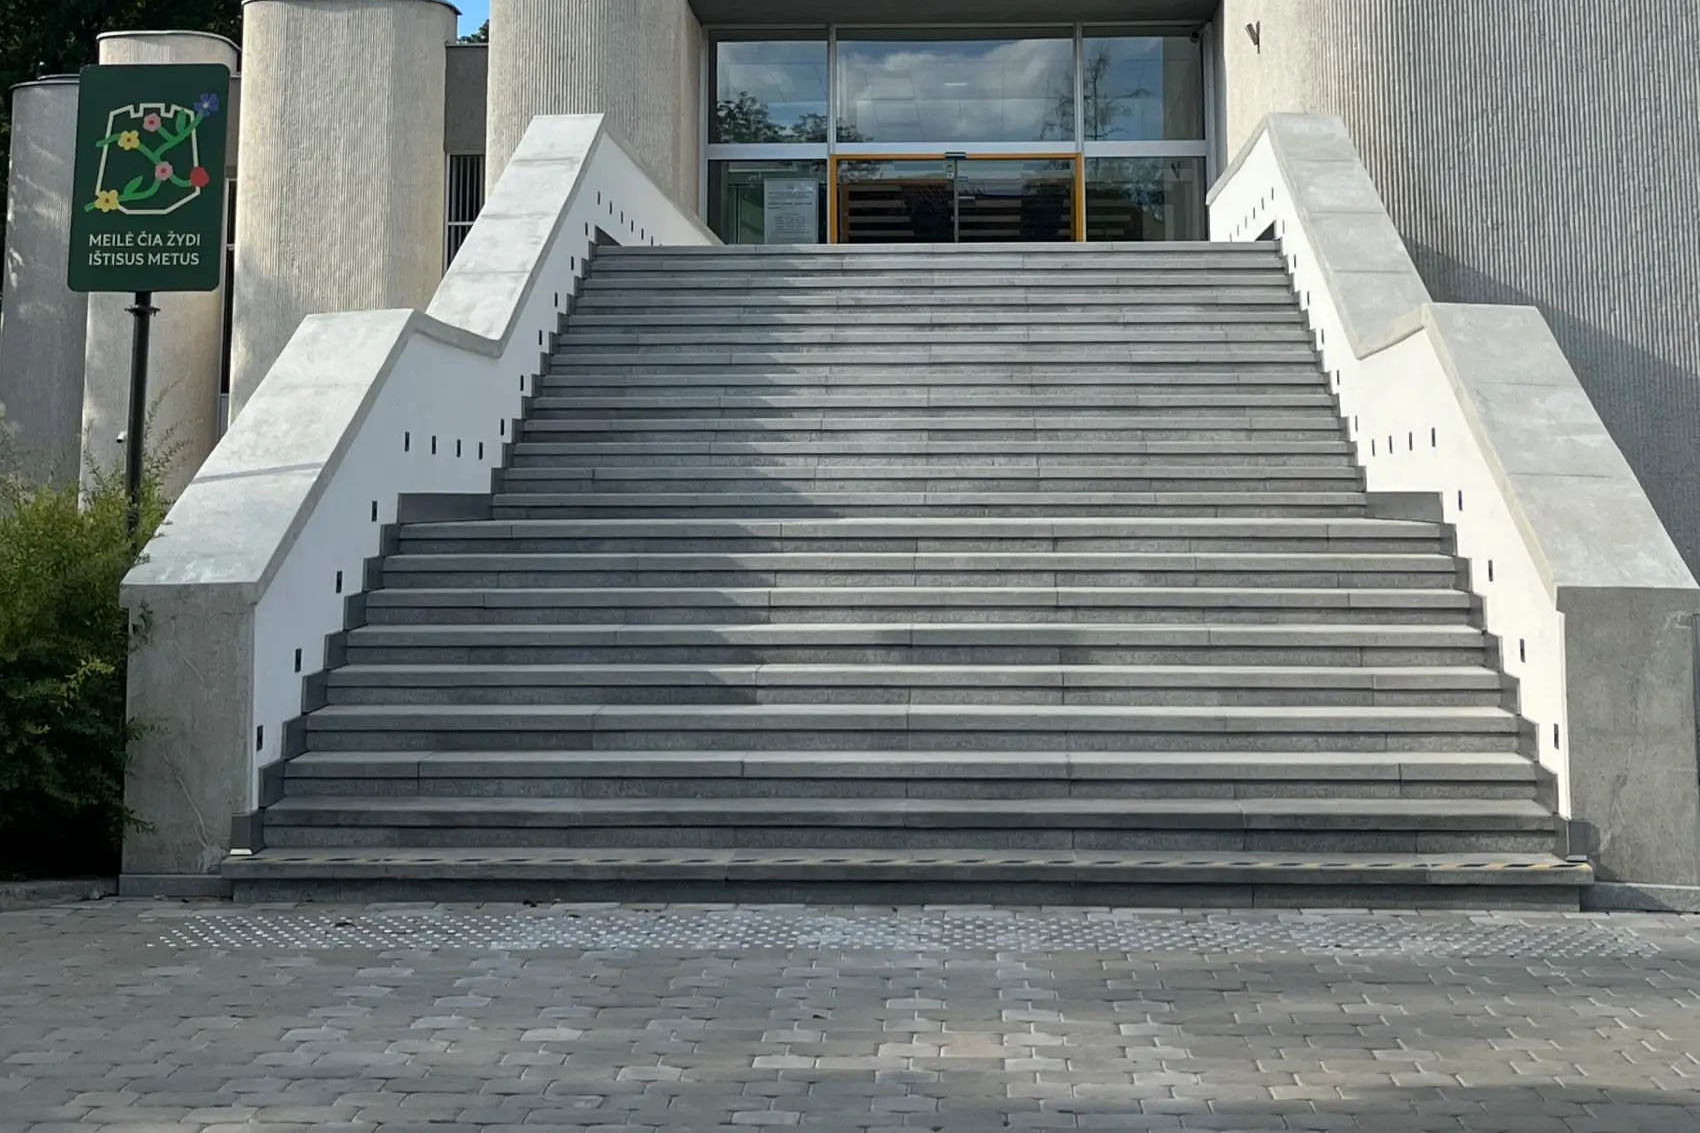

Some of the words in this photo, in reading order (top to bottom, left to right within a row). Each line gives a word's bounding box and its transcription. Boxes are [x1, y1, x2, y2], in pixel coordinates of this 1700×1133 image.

[88, 231, 134, 247] MEILĖ
[137, 230, 163, 247] ČIA
[166, 230, 201, 247] ŽYDI
[88, 250, 144, 266] IŠTISUS
[147, 252, 200, 265] METUS
